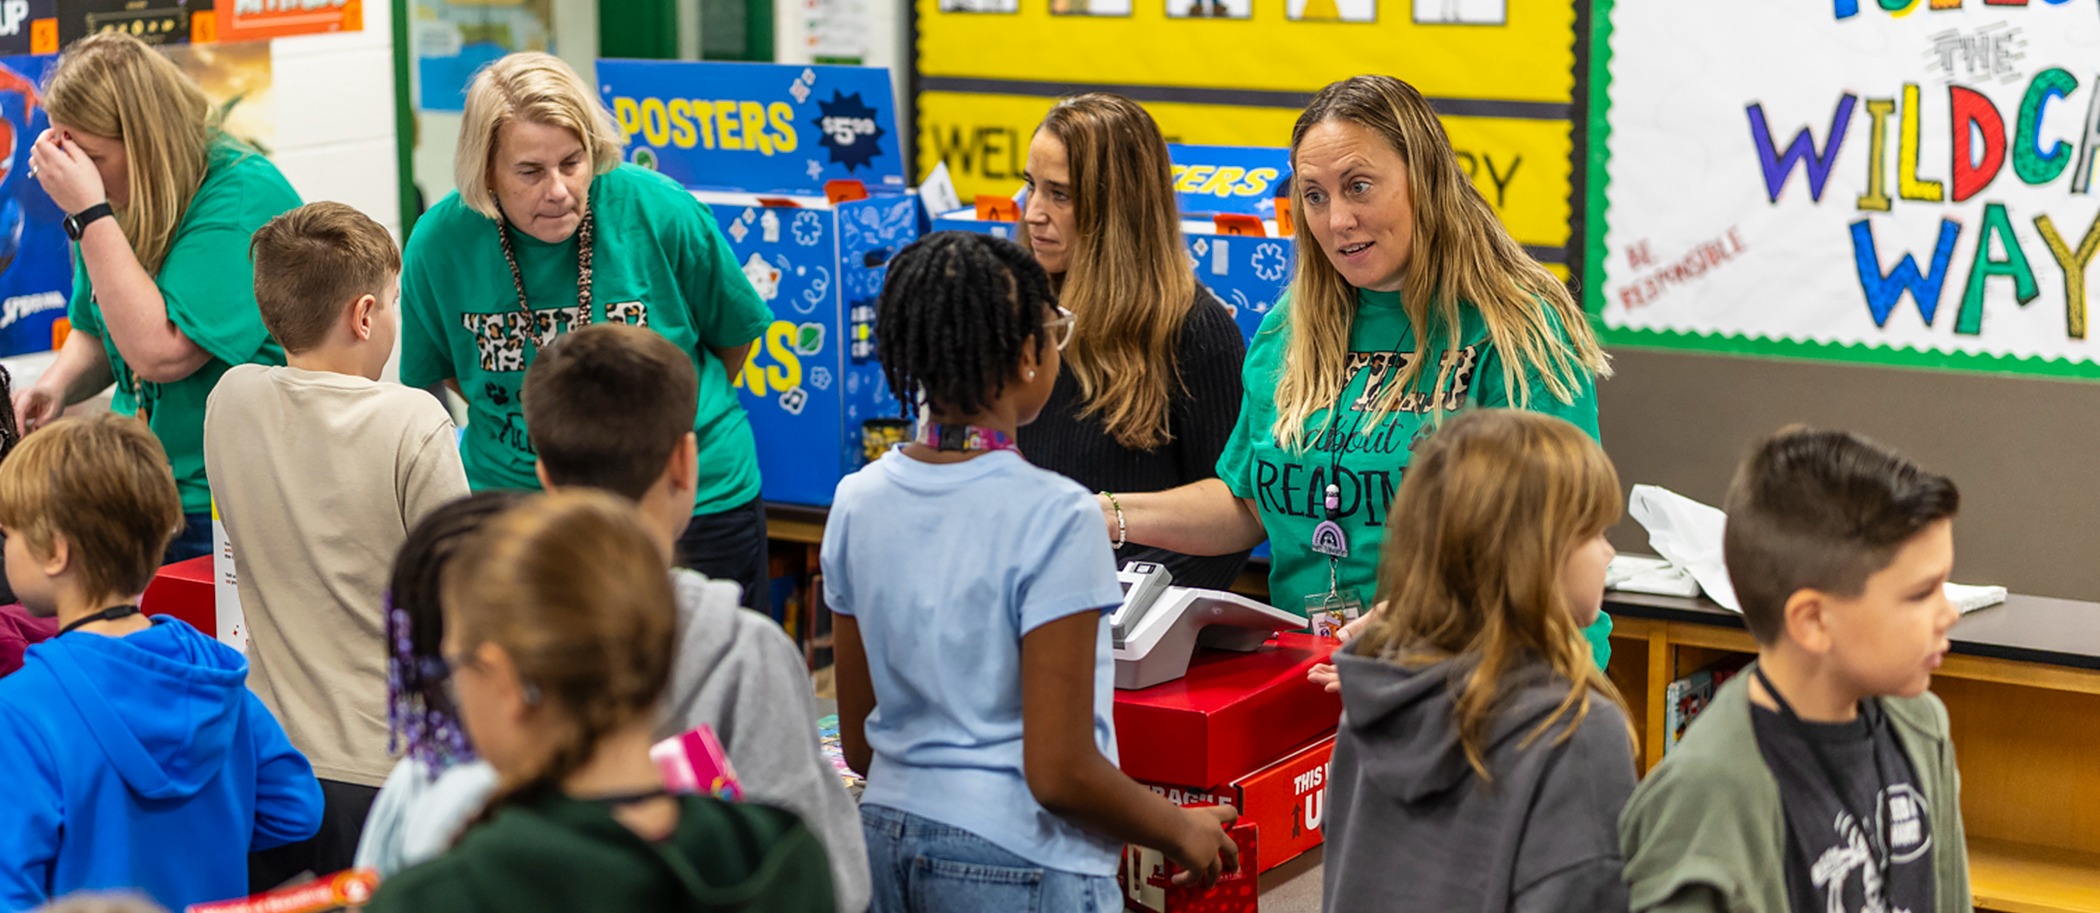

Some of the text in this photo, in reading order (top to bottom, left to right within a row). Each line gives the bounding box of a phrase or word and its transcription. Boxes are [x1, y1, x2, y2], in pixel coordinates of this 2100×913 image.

[1934, 34, 2014, 74] THE
[613, 97, 798, 156] POSTERS
[1624, 238, 1659, 271] BE
[1849, 203, 2100, 340] WAY
[1303, 414, 1404, 454] about
[1294, 765, 1323, 796] THIS
